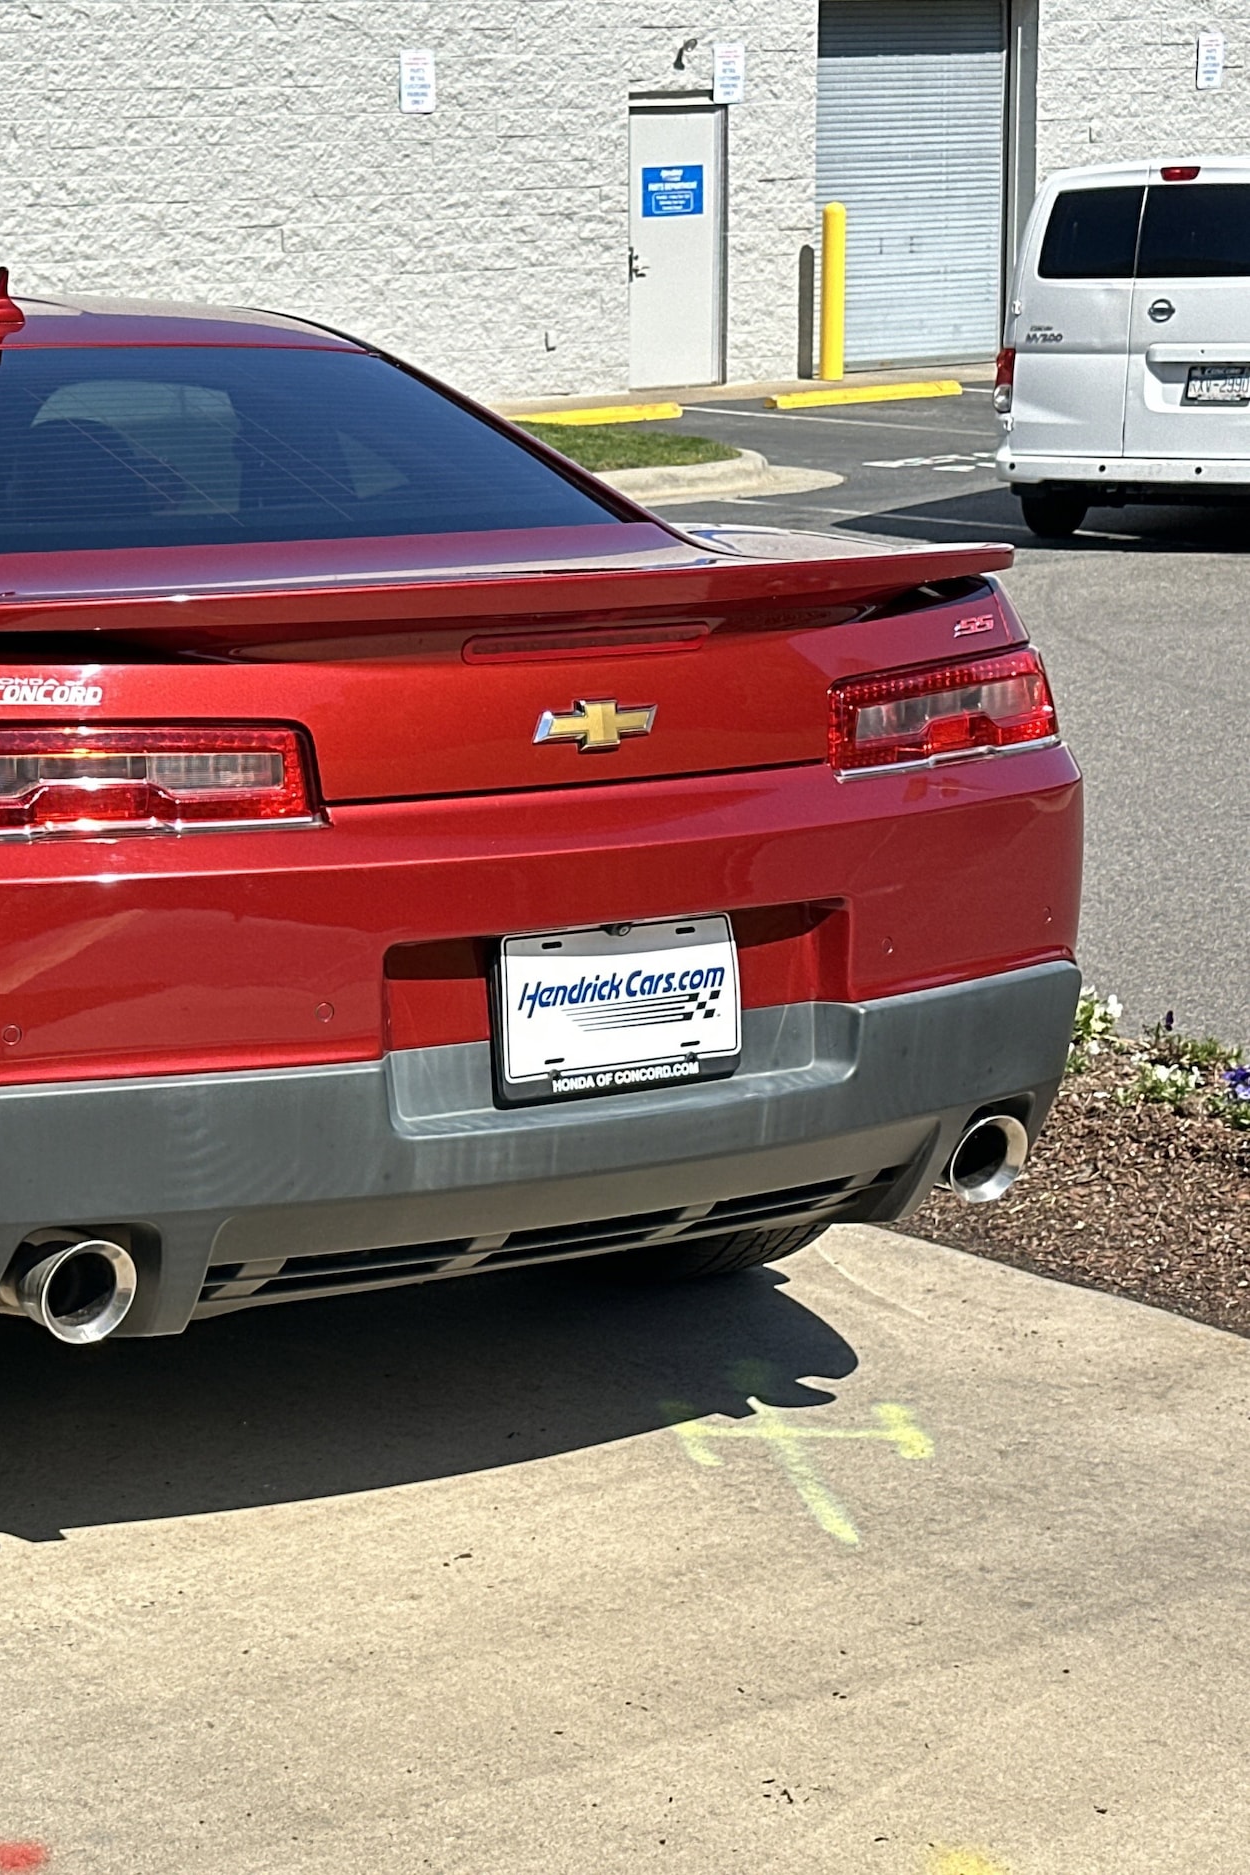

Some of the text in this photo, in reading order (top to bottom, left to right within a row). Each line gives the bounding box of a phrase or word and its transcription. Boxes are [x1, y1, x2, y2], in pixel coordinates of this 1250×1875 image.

[953, 613, 994, 638] SS
[552, 1061, 699, 1093] HONDA OF CONCORD.COM
